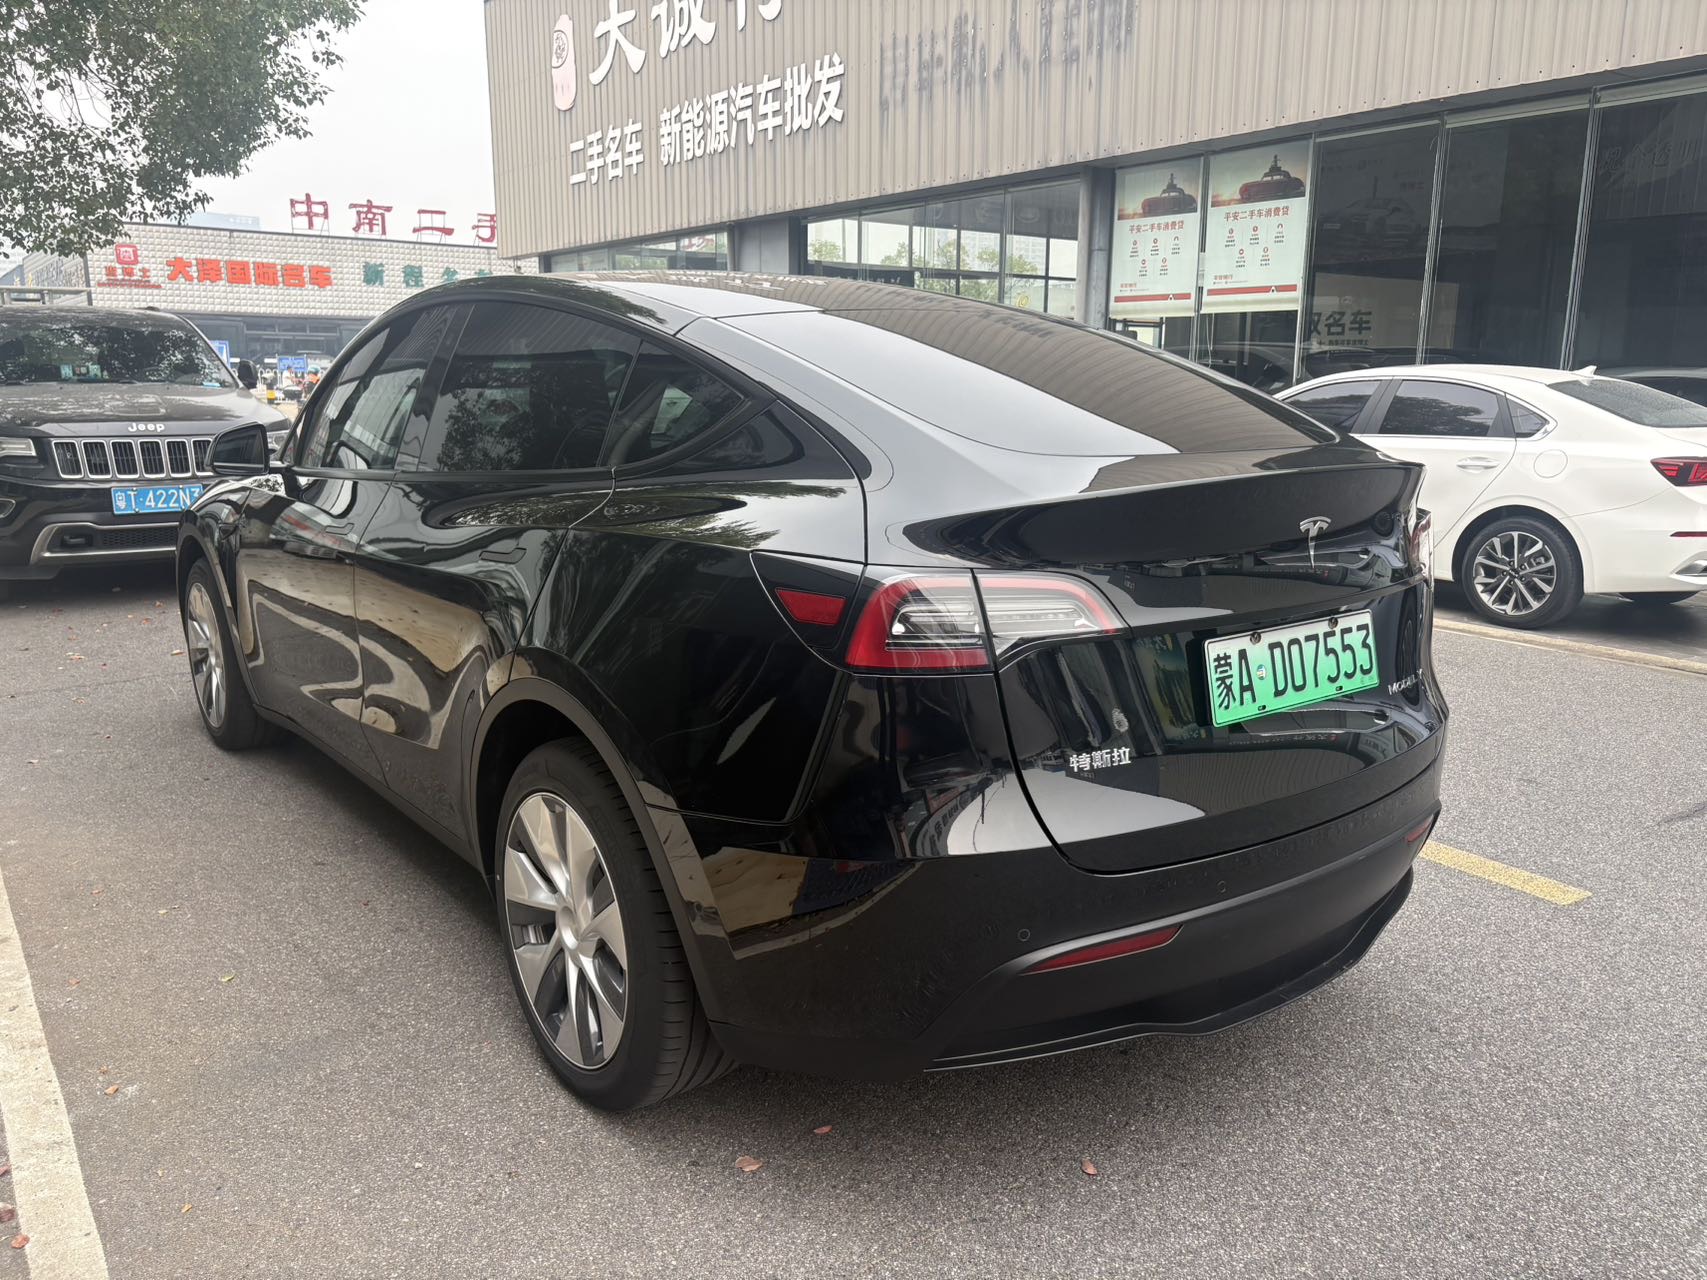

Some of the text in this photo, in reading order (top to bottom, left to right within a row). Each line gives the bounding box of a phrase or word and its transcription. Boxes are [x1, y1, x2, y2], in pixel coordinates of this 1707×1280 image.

[569, 118, 645, 185] 二手名车
[659, 51, 845, 167] 新能源汽车批发
[166, 256, 333, 289] 大泽国际名车
[127, 422, 165, 433] Jeep
[1069, 746, 1131, 772] 特斯拉
